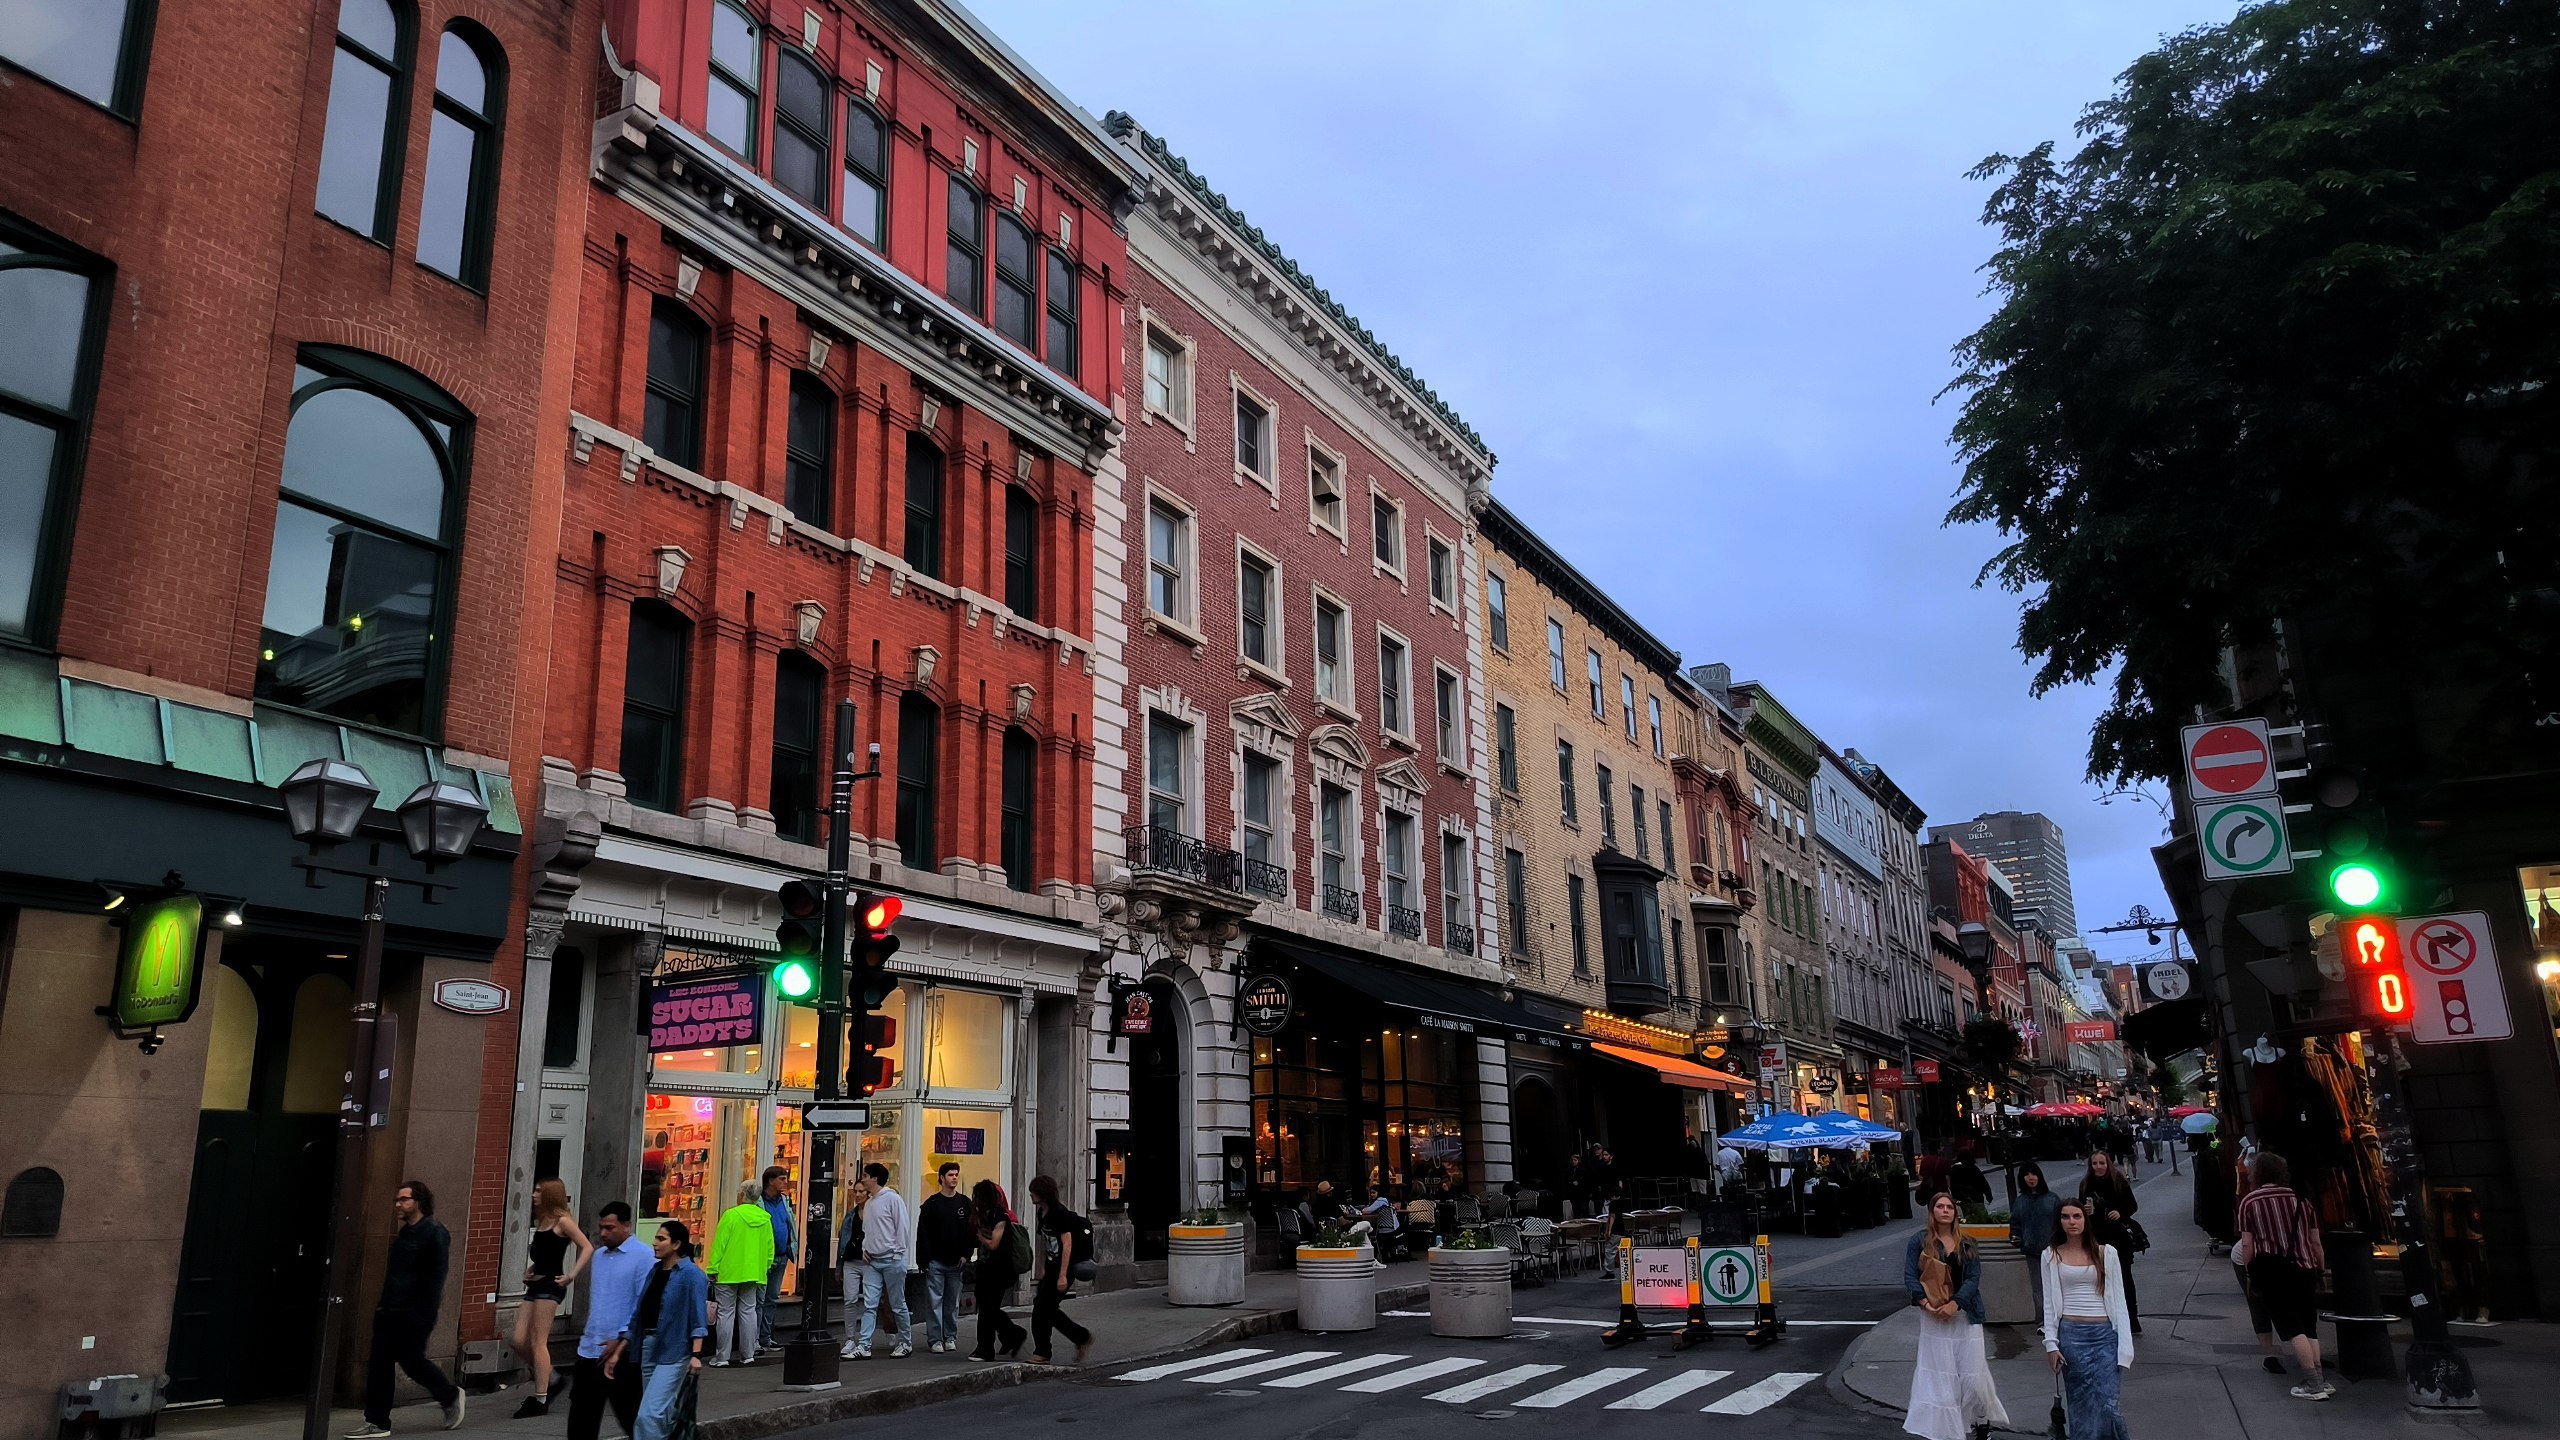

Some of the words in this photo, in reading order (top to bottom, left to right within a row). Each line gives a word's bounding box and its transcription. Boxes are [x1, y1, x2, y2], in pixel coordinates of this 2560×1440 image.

[1967, 832, 1994, 840] DELTA
[455, 990, 489, 1000] Saint-Jean
[669, 988, 689, 997] LES
[690, 982, 739, 995] BONBONS
[2378, 973, 2404, 1013] 0
[651, 993, 753, 1025] SUGAR
[1420, 1015, 1433, 1027] CAFÉ
[650, 1019, 753, 1047] DADDY'S
[1790, 1138, 1817, 1146] CHEVAL
[1818, 1136, 1841, 1144] BLANC
[1649, 1264, 1669, 1273] RUE
[1636, 1276, 1684, 1288] PIÉTONNE
